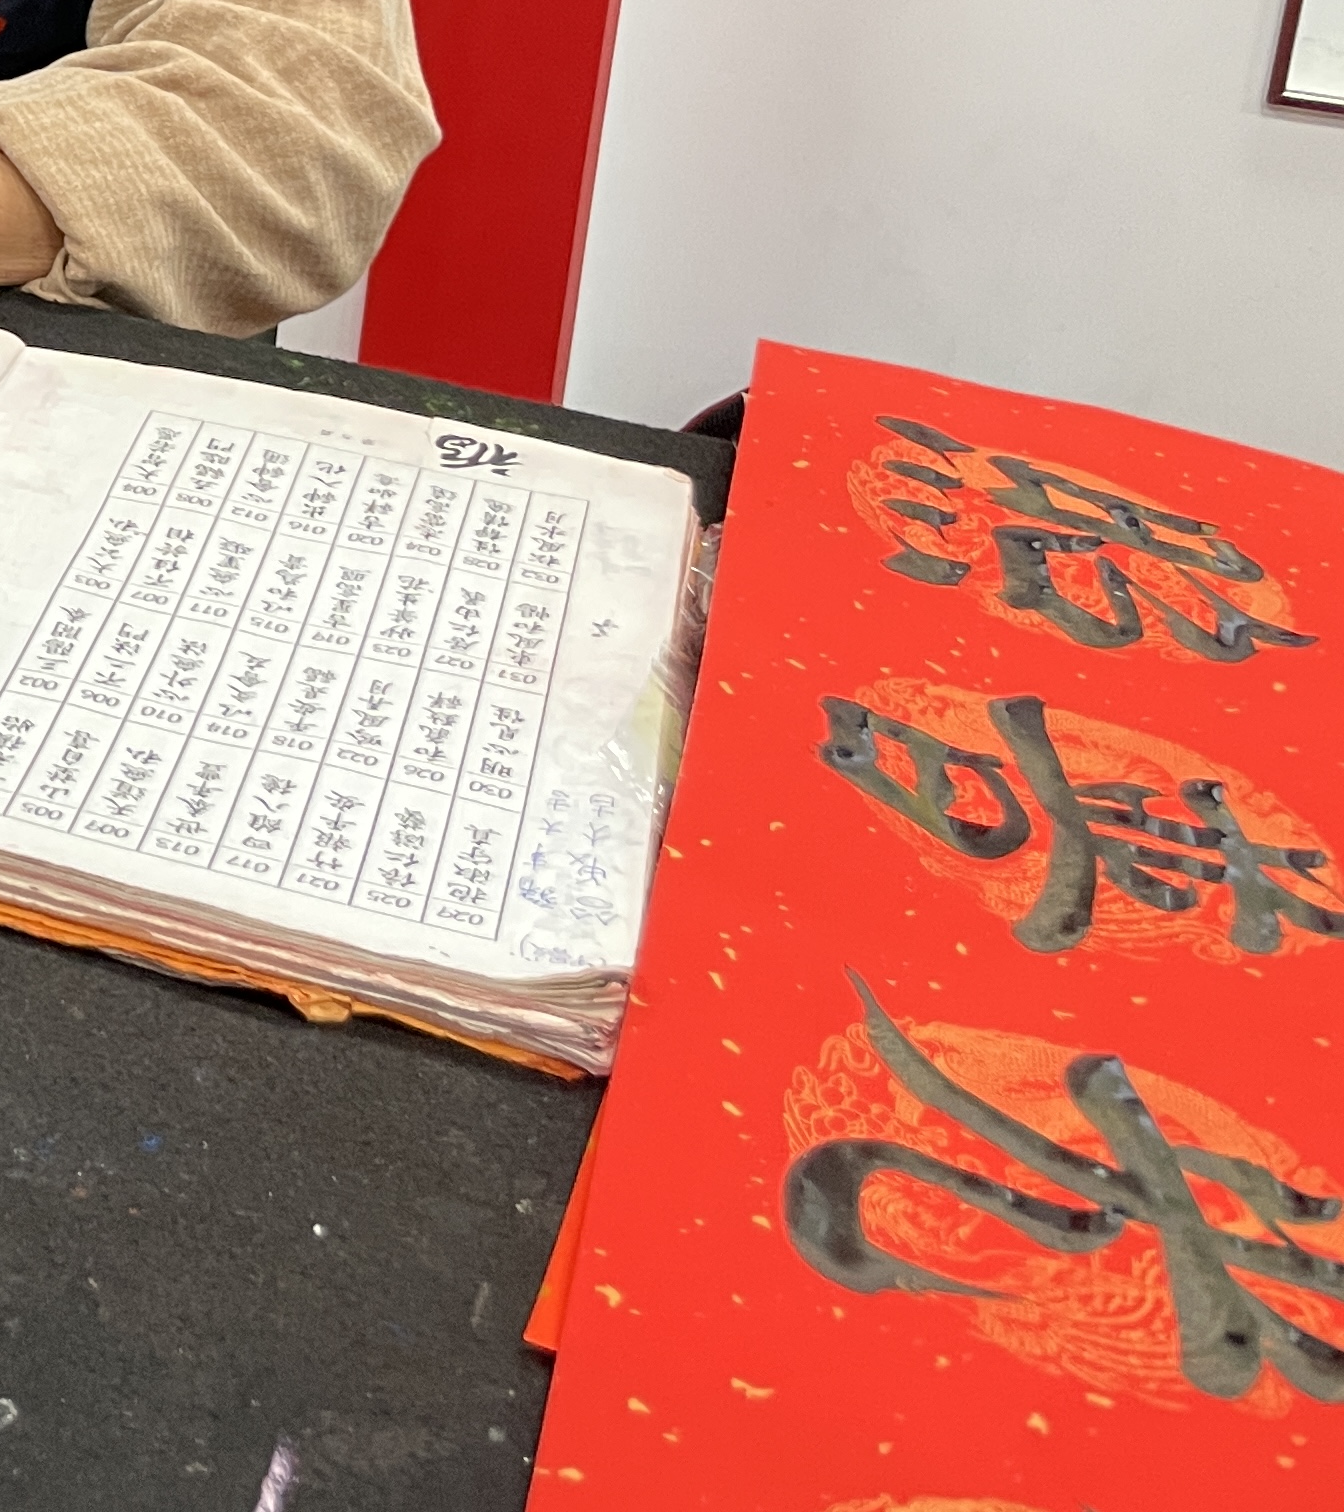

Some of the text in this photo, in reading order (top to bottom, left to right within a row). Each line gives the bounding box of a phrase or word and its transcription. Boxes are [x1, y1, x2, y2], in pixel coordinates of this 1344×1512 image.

[122, 482, 157, 496] 004
[301, 460, 347, 517] 出神入化
[175, 492, 213, 507] 008
[230, 505, 268, 521] 012
[287, 520, 327, 534] 016
[347, 532, 384, 545] 020
[405, 541, 441, 556] 024
[462, 555, 500, 570] 028
[74, 574, 110, 589] 003
[520, 567, 560, 583] 032
[129, 590, 168, 605] 007
[189, 602, 228, 617] 011
[250, 616, 289, 633] 015
[311, 631, 350, 645] 019
[93, 621, 149, 688] 不二法門
[372, 643, 412, 657] 023
[434, 654, 475, 669] 027
[19, 674, 59, 690] 002
[218, 650, 271, 717] 以文會友
[497, 669, 537, 684] 031
[80, 688, 120, 707] 006
[283, 666, 336, 732] 平安是福
[140, 705, 183, 723] 010
[206, 721, 249, 738] 014
[271, 735, 314, 750] 018
[479, 703, 525, 778] 明心見性
[336, 747, 379, 766] 022
[403, 764, 445, 782] 026
[468, 780, 513, 799] 030
[20, 801, 64, 821] 005
[83, 819, 131, 838] 009
[155, 837, 200, 855] 013
[225, 855, 271, 873] 017
[295, 872, 340, 891] 021
[366, 889, 411, 908] 025
[436, 905, 484, 925] 029
